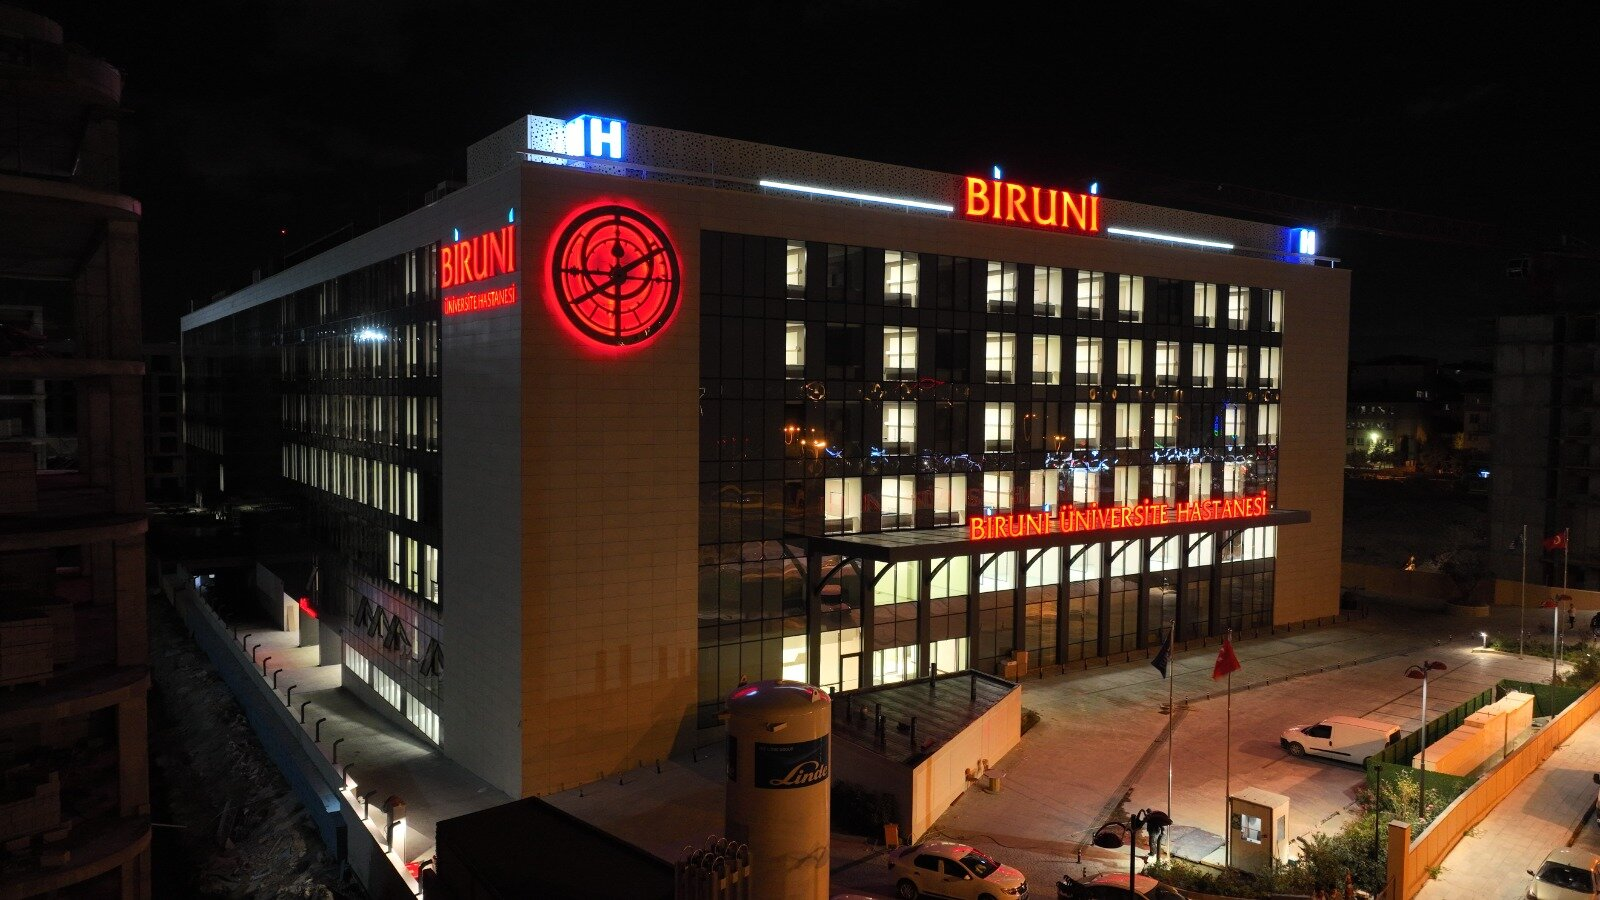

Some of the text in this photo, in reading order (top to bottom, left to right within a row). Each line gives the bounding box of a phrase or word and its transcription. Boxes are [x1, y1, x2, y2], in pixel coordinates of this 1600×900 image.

[590, 118, 622, 159] H
[478, 283, 516, 309] HASTANESİ
[1060, 498, 1169, 533] ÜNİVERSİTE
[1177, 490, 1268, 523] HASTANESİ
[769, 760, 829, 786] Linde
